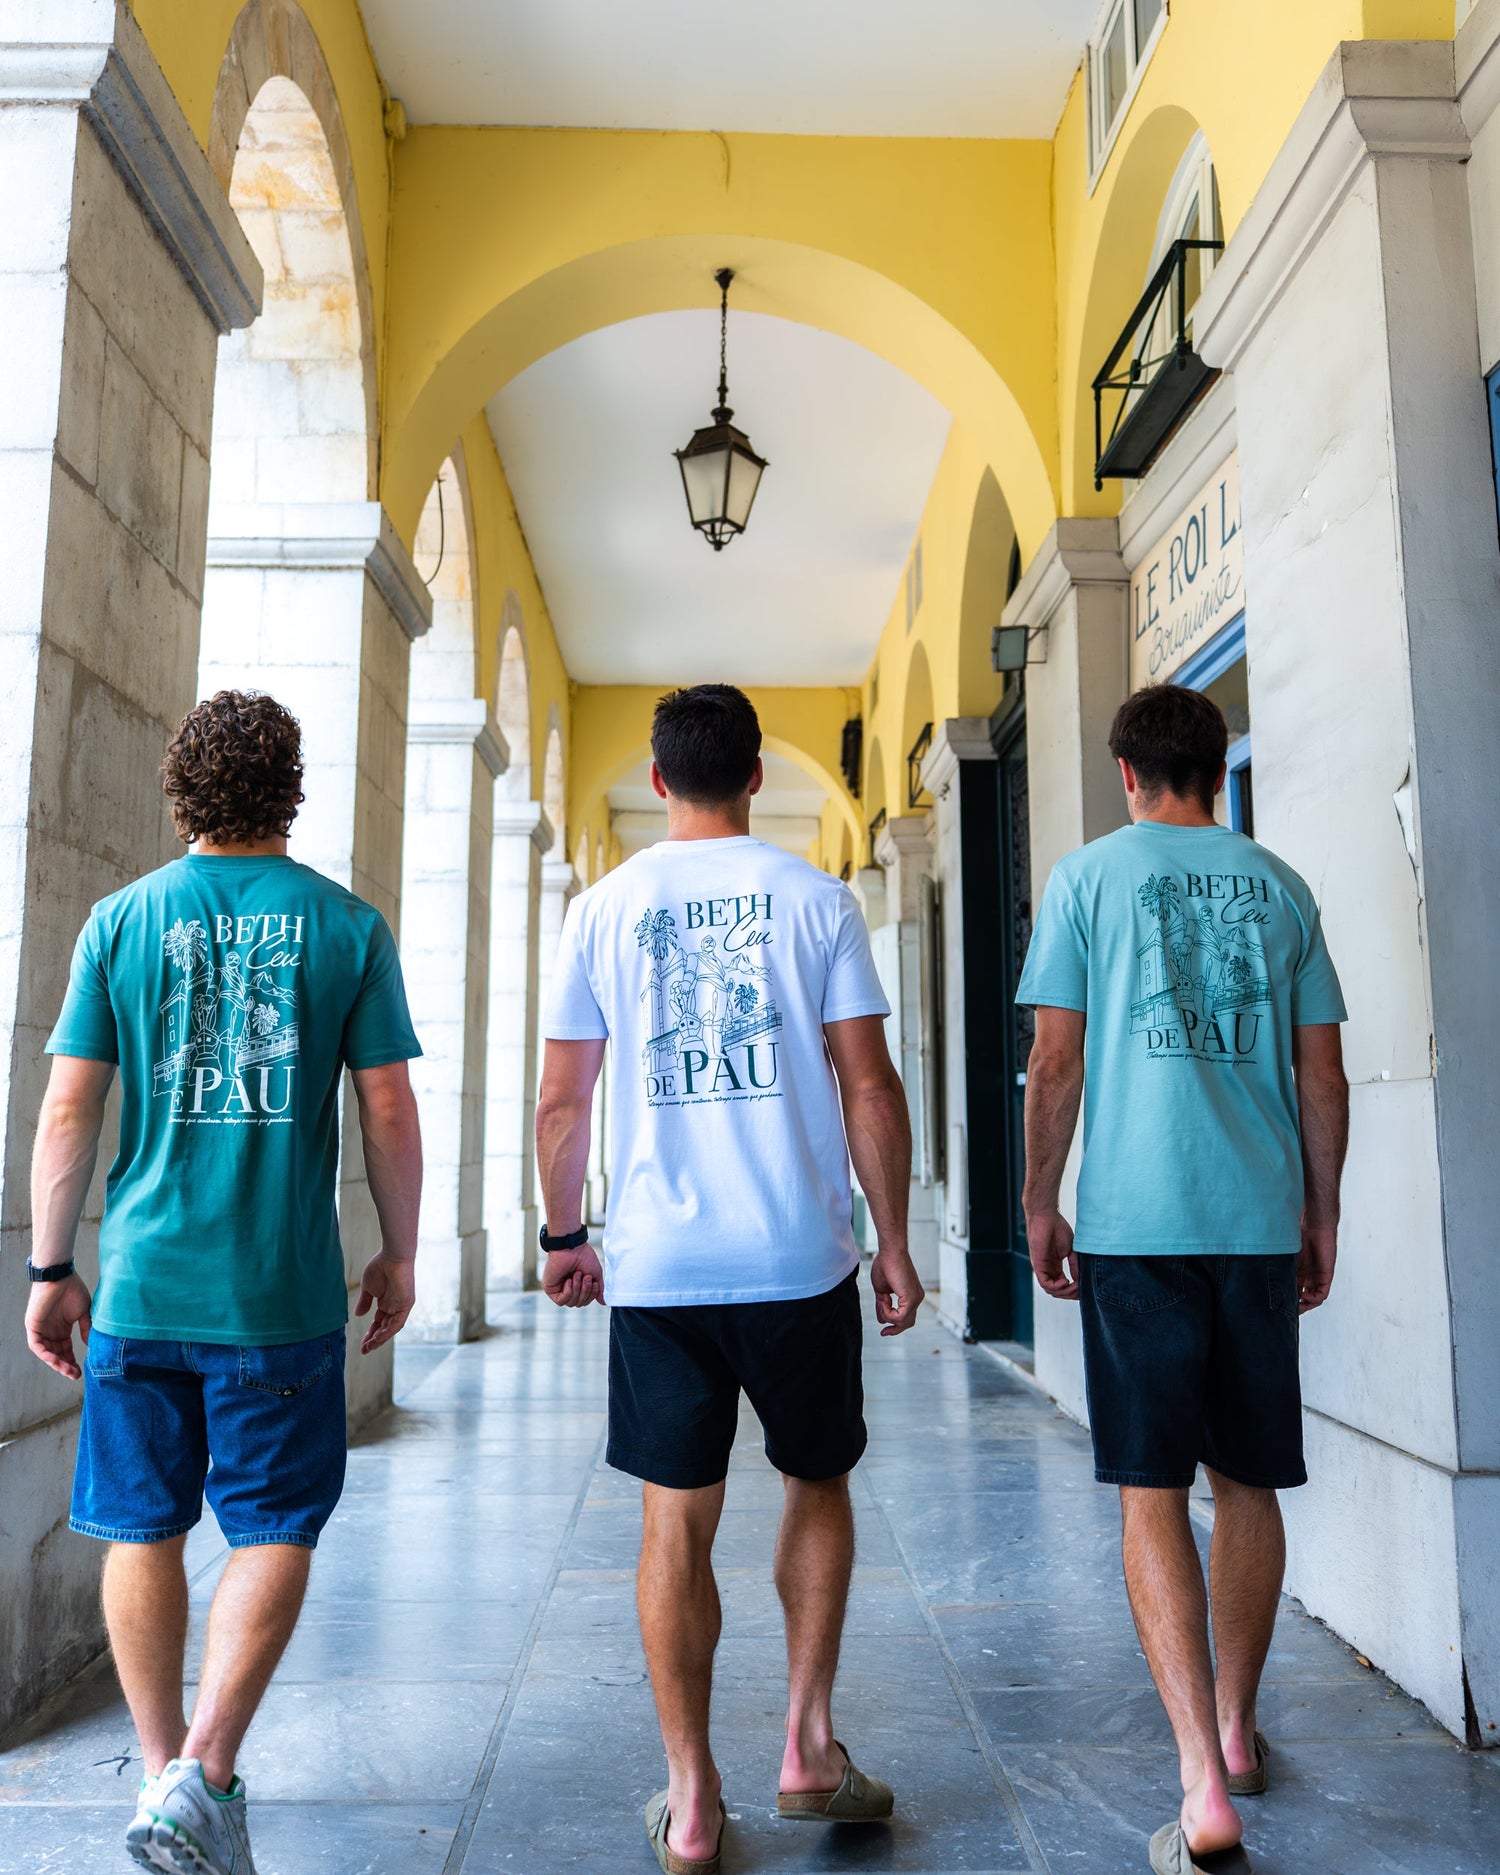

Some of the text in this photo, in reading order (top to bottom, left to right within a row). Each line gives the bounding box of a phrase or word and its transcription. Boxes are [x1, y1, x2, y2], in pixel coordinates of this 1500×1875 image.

[1134, 480, 1242, 642] LE ROI L
[1184, 872, 1270, 903] BETH
[684, 894, 774, 930] BETH
[1221, 892, 1271, 924] Ceu
[214, 914, 304, 943] BETH
[724, 912, 773, 952] Ceu
[246, 932, 302, 969] Ceu
[1146, 1008, 1264, 1055] DE PAU
[646, 1041, 780, 1098] DE PAU
[188, 1066, 296, 1113] PAU
